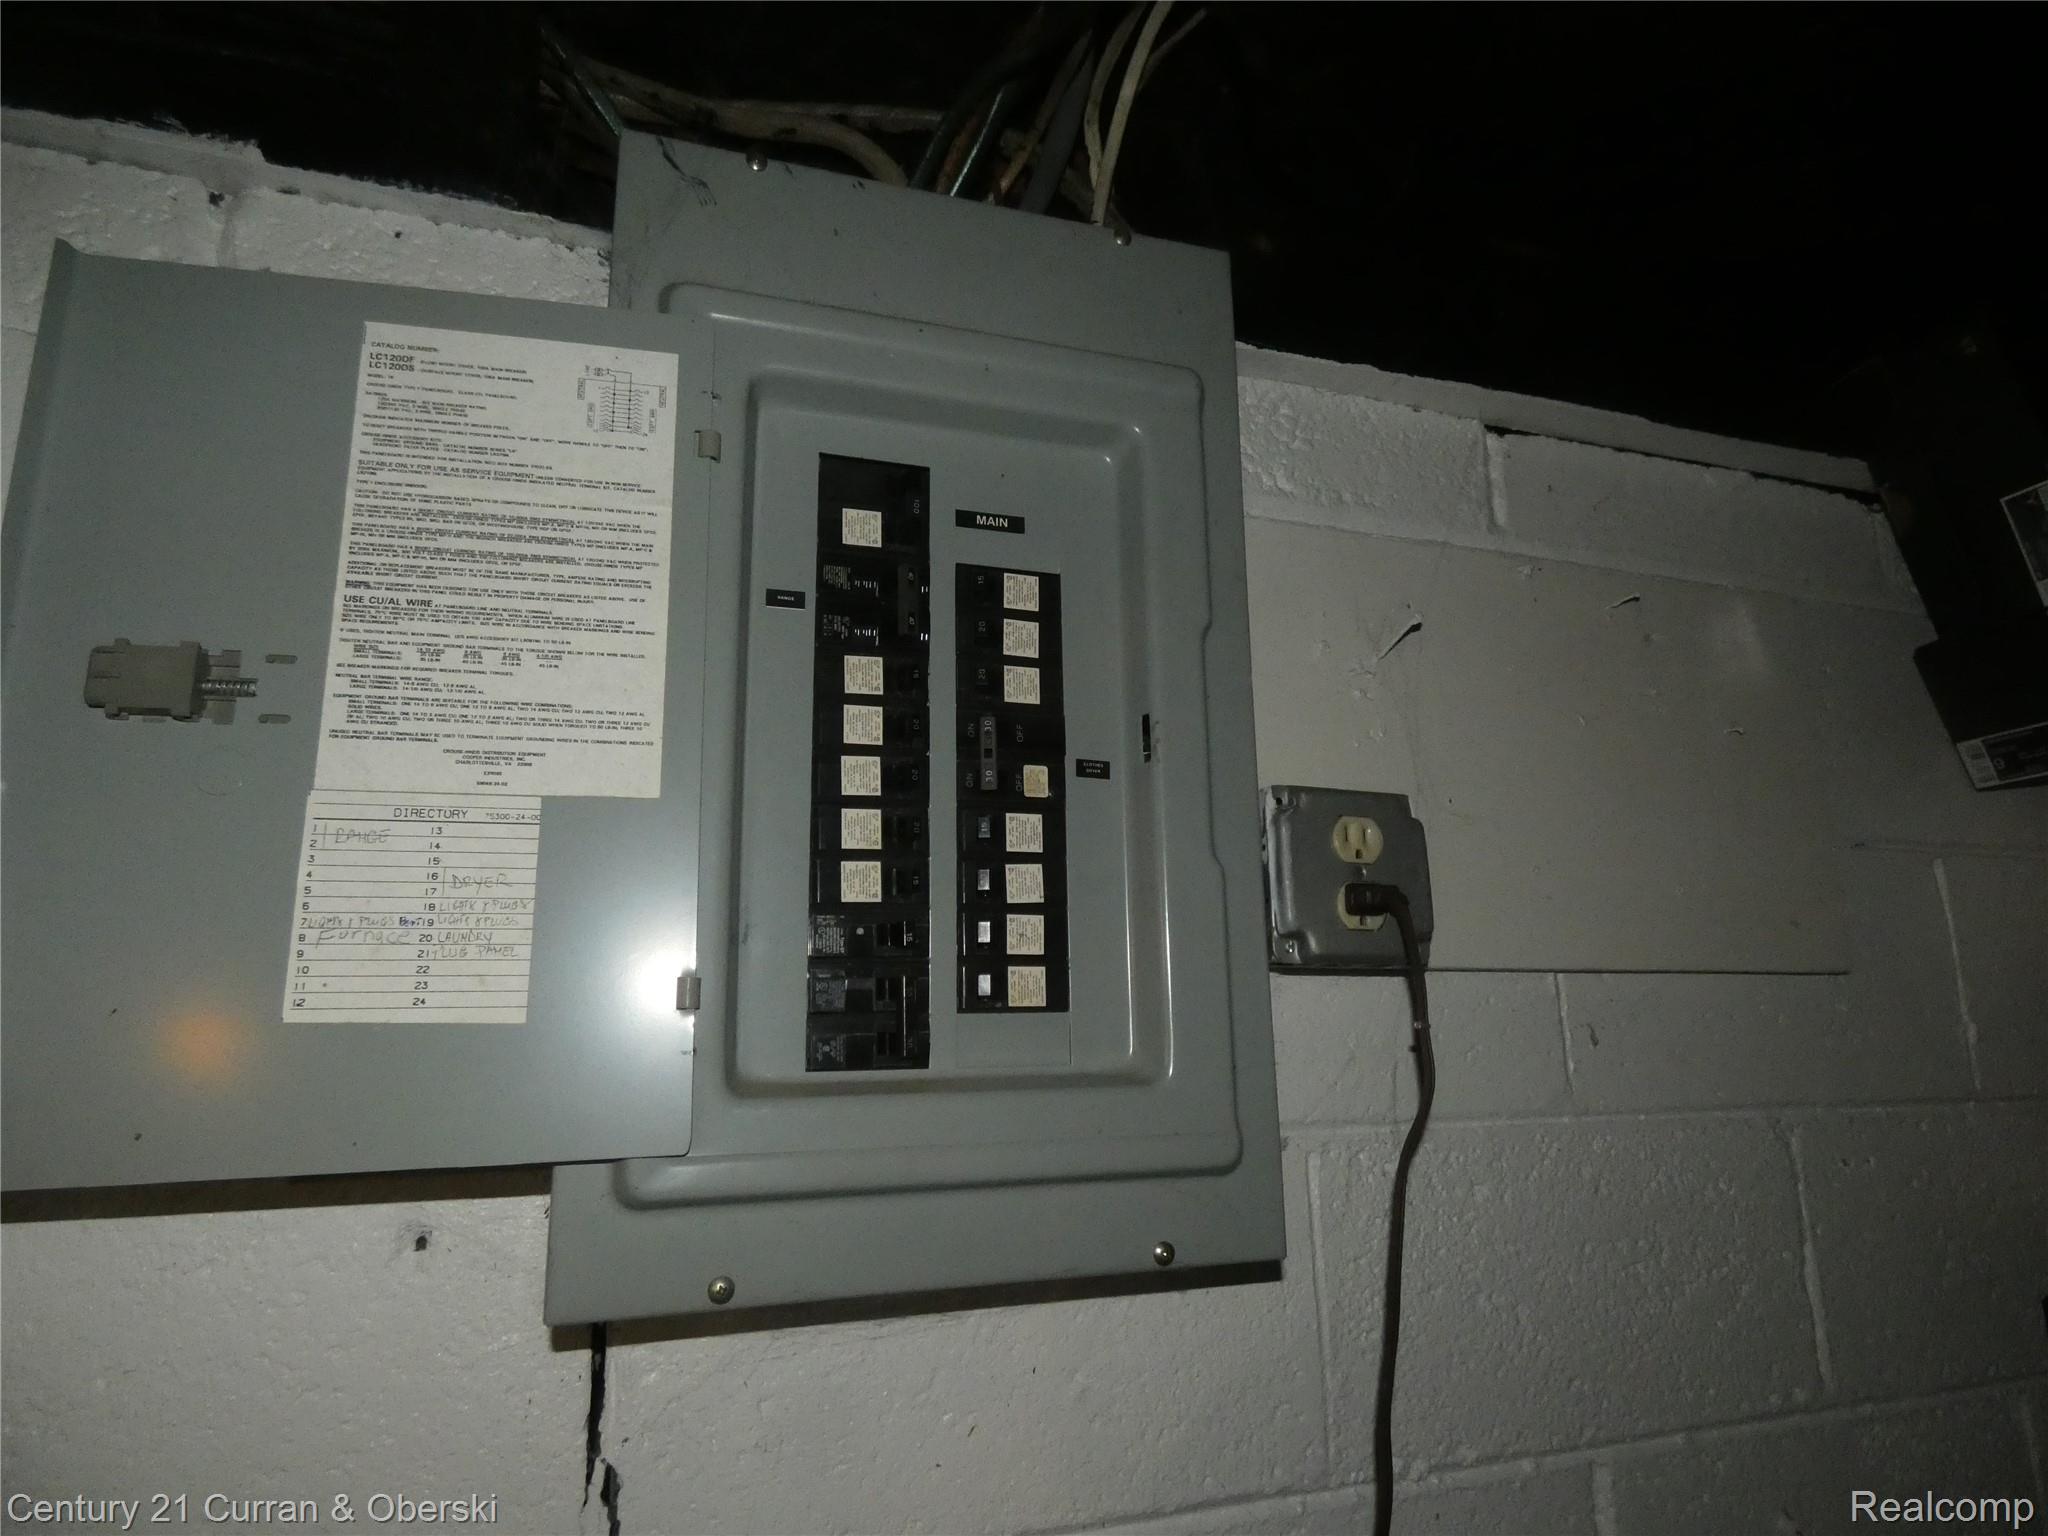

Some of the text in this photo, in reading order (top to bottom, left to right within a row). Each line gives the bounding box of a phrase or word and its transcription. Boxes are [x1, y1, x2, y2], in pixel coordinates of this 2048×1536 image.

[371, 341, 405, 349] CATALOG
[369, 351, 414, 363] LC120DF
[368, 360, 415, 372] LC120DS
[357, 459, 393, 467] SUITABLE
[461, 467, 491, 475] SERVICE
[493, 469, 534, 479] EQUIPMENT
[976, 515, 1009, 528] MAIN
[343, 594, 365, 604] USE
[368, 595, 402, 605] CU/AL
[404, 597, 433, 607] WIRE
[984, 719, 993, 732] 30
[1016, 723, 1024, 743] OFF
[984, 769, 993, 783] 30
[394, 807, 469, 820] DIRECTORY
[313, 824, 319, 833] 1
[432, 826, 444, 836] 13
[309, 840, 319, 849] 2
[430, 842, 442, 851] 14
[307, 855, 317, 864] 3
[428, 857, 440, 866] 15
[306, 871, 315, 879] 4
[427, 872, 439, 881] 16
[304, 886, 314, 895] 5
[425, 888, 437, 896] 17
[302, 902, 311, 911] 6
[424, 903, 436, 912] 18
[300, 917, 309, 927] 7
[422, 918, 434, 927] 19
[298, 933, 307, 943] 8
[418, 934, 433, 943] 20
[437, 929, 493, 945] LAUNDRY
[296, 949, 305, 958] 9
[417, 949, 430, 959] 21
[296, 965, 311, 975] 10
[415, 965, 430, 975] 22
[294, 981, 307, 991] 11
[414, 981, 429, 991] 23
[292, 998, 307, 1008] 12
[412, 997, 427, 1007] 24
